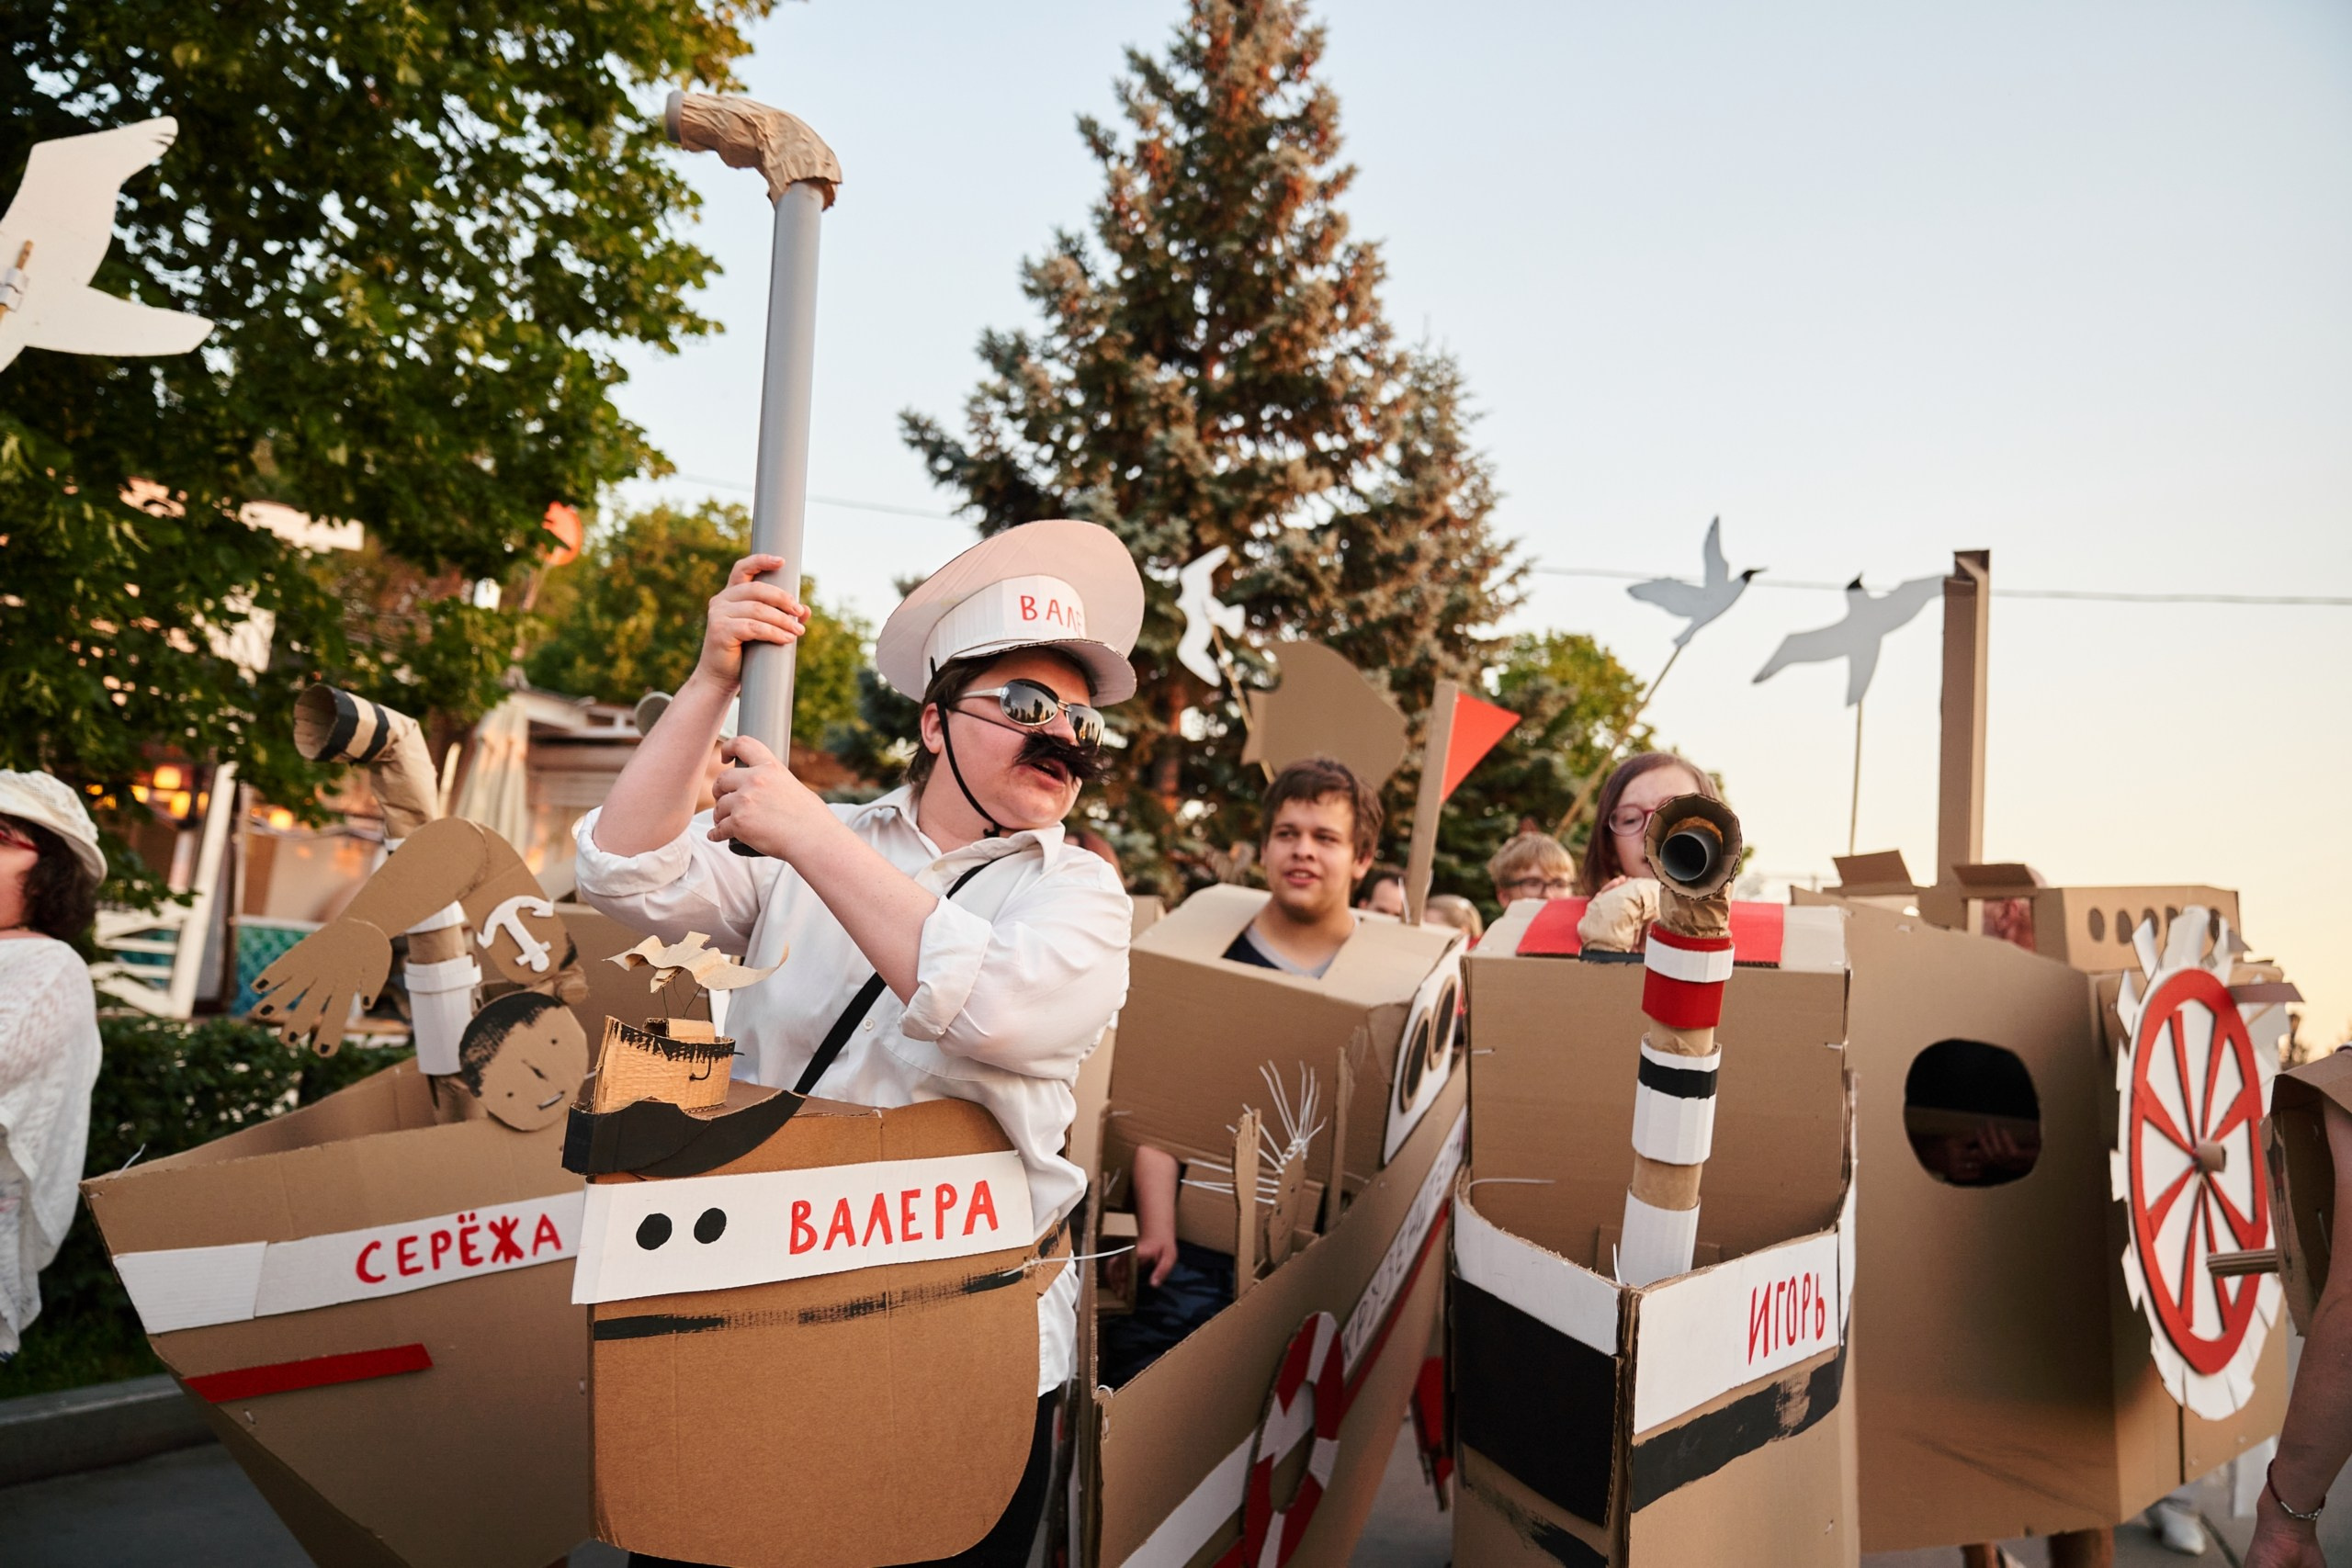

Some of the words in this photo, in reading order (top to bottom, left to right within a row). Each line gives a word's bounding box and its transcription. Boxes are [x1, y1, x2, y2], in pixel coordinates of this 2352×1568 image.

[356, 1213, 562, 1283] СЕРЁЖА
[789, 1179, 999, 1255] ВАЛЕРА
[1748, 1272, 1826, 1366] ИГОРЬ
